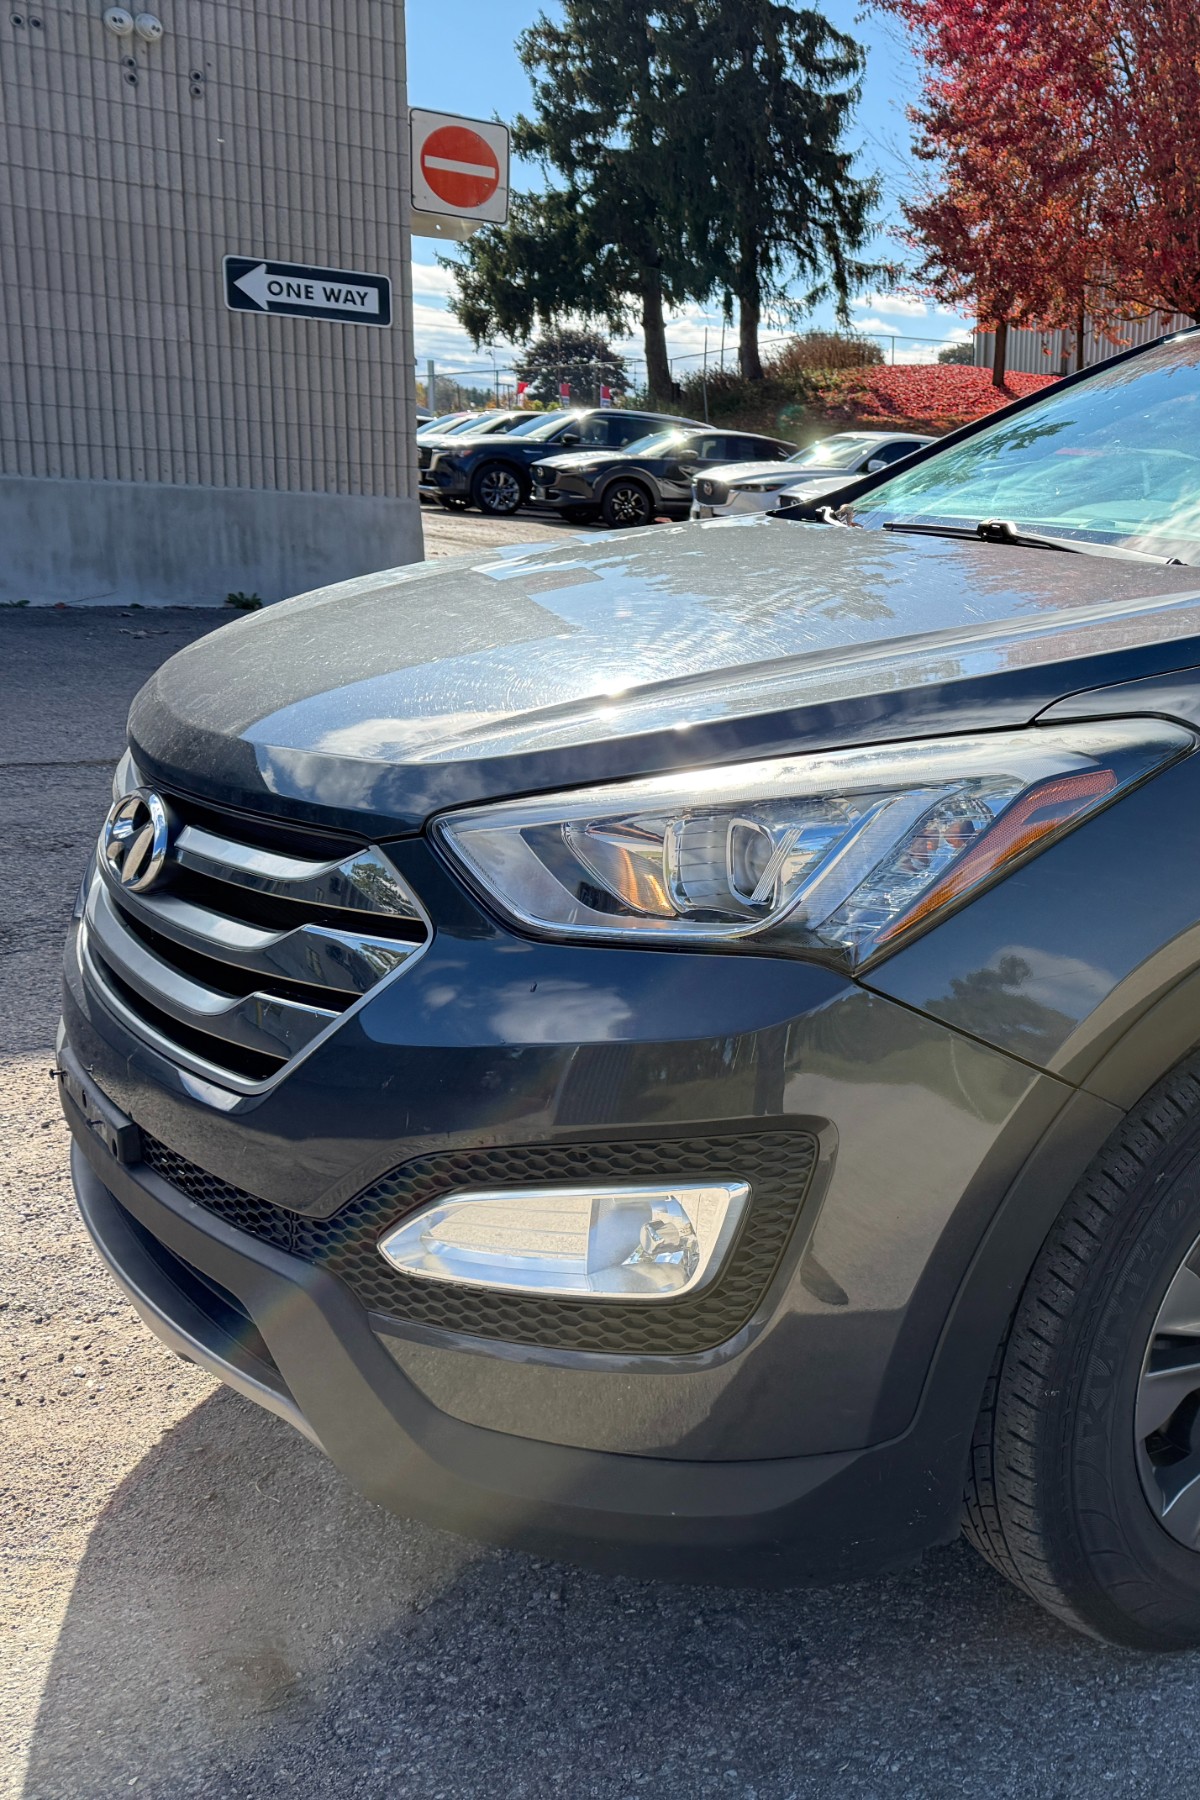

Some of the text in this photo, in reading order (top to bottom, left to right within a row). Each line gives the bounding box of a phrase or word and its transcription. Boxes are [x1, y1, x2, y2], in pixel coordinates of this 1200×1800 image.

[267, 280, 368, 306] ONE WAY
[1084, 1187, 1193, 1441] KUMHO
